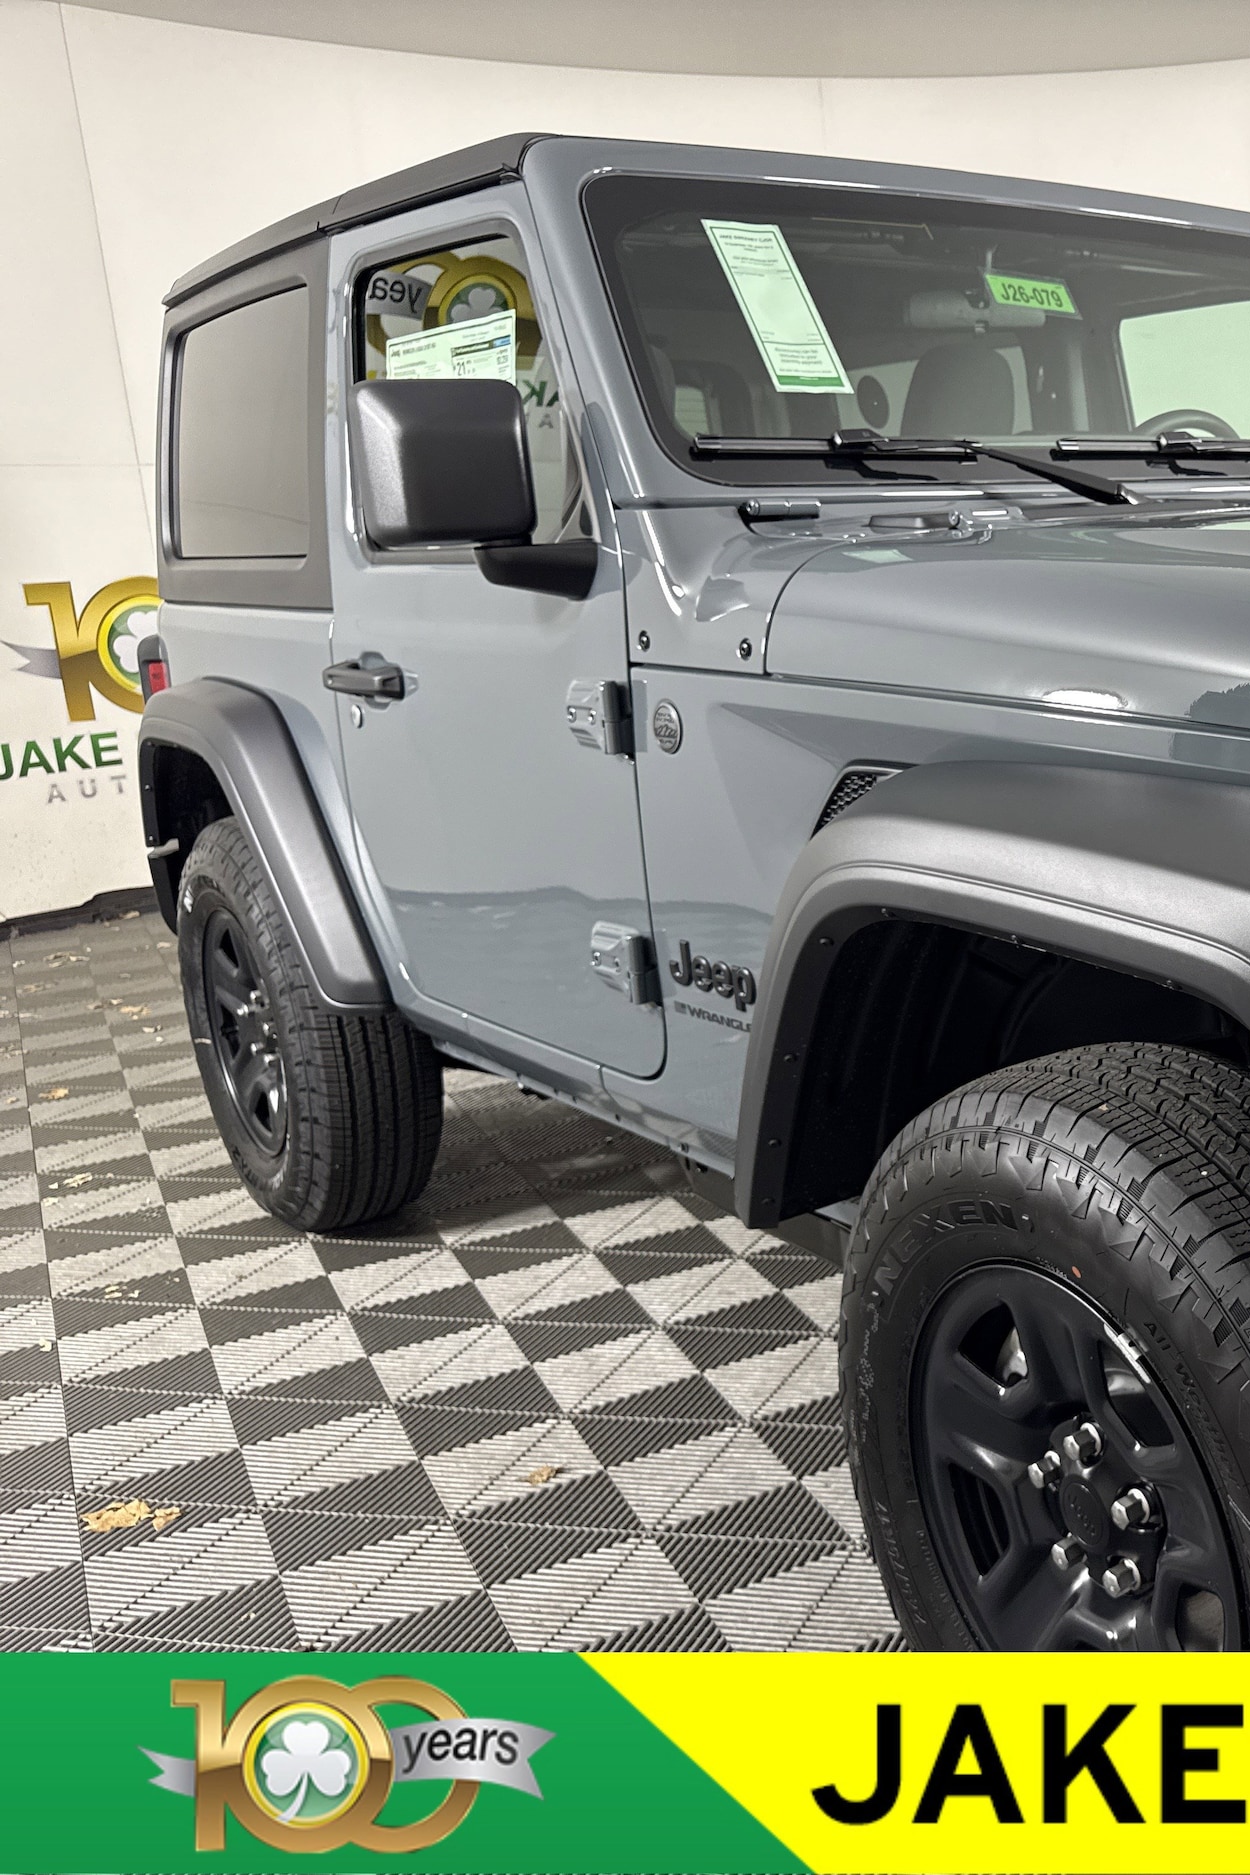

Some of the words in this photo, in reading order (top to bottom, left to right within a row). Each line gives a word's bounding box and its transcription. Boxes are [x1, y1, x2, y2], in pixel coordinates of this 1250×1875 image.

[1001, 283, 1063, 308] J26-079
[0, 731, 123, 781] JAKE
[669, 939, 757, 1013] Jeep
[874, 1199, 1019, 1296] NEXEN
